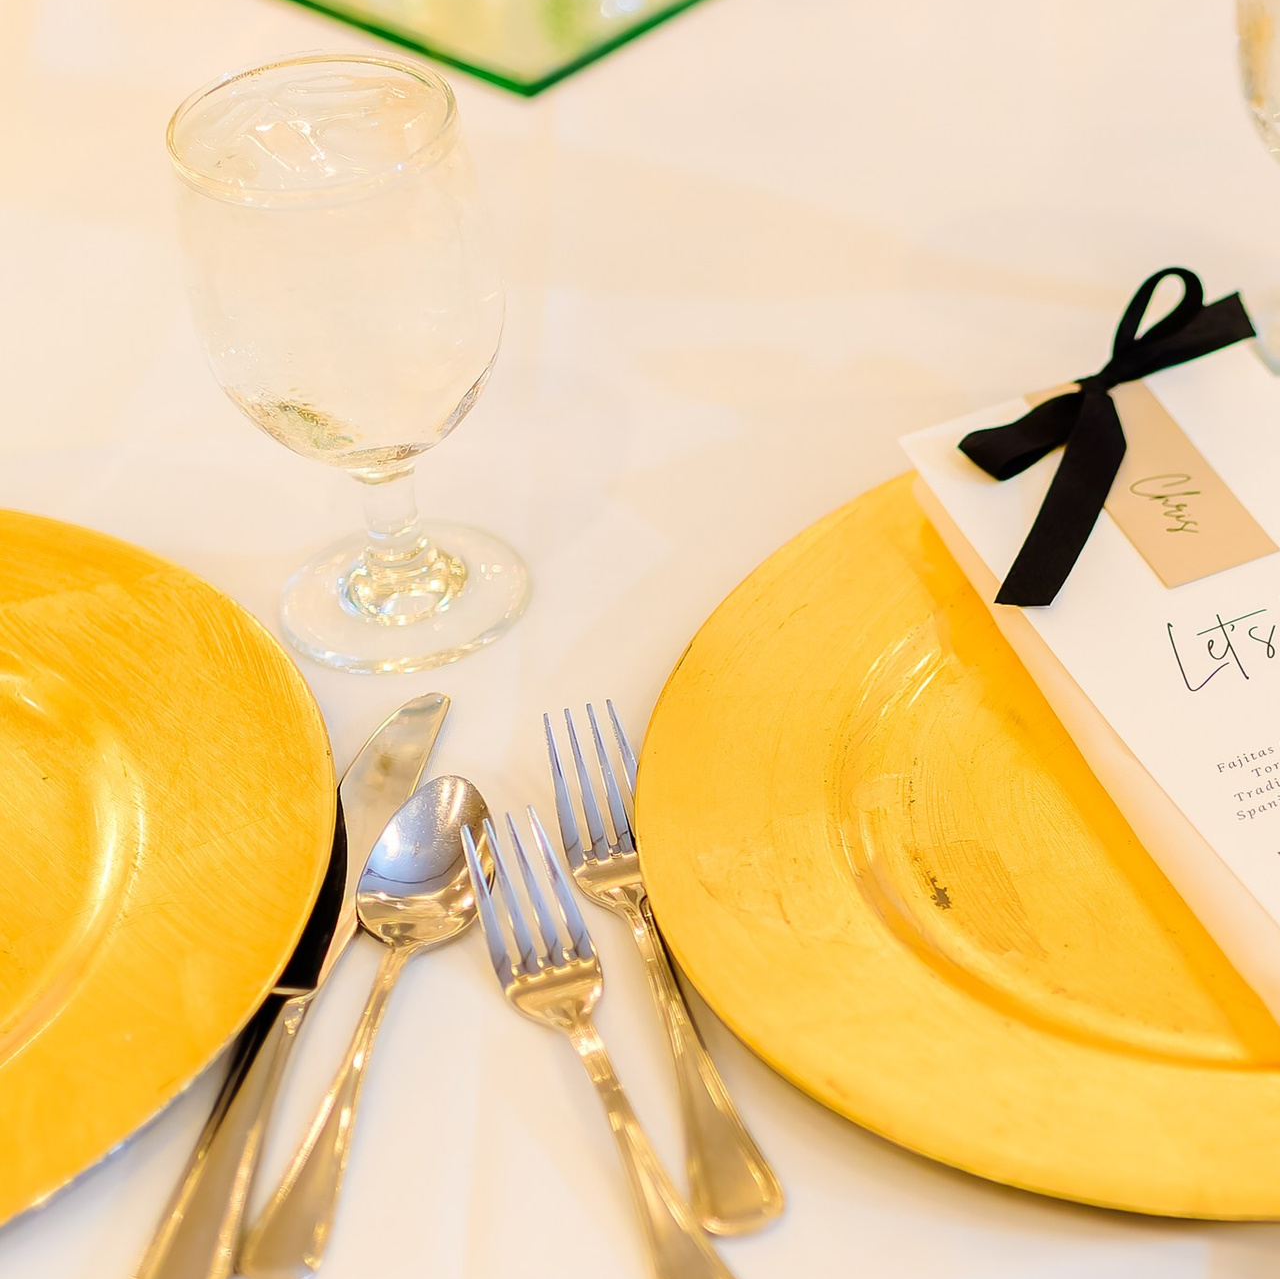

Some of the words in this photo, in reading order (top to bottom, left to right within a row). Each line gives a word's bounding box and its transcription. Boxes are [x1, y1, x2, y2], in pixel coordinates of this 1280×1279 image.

[1130, 474, 1200, 533] Chris
[1167, 609, 1275, 691] Let's
[1216, 746, 1275, 773] Fajitas
